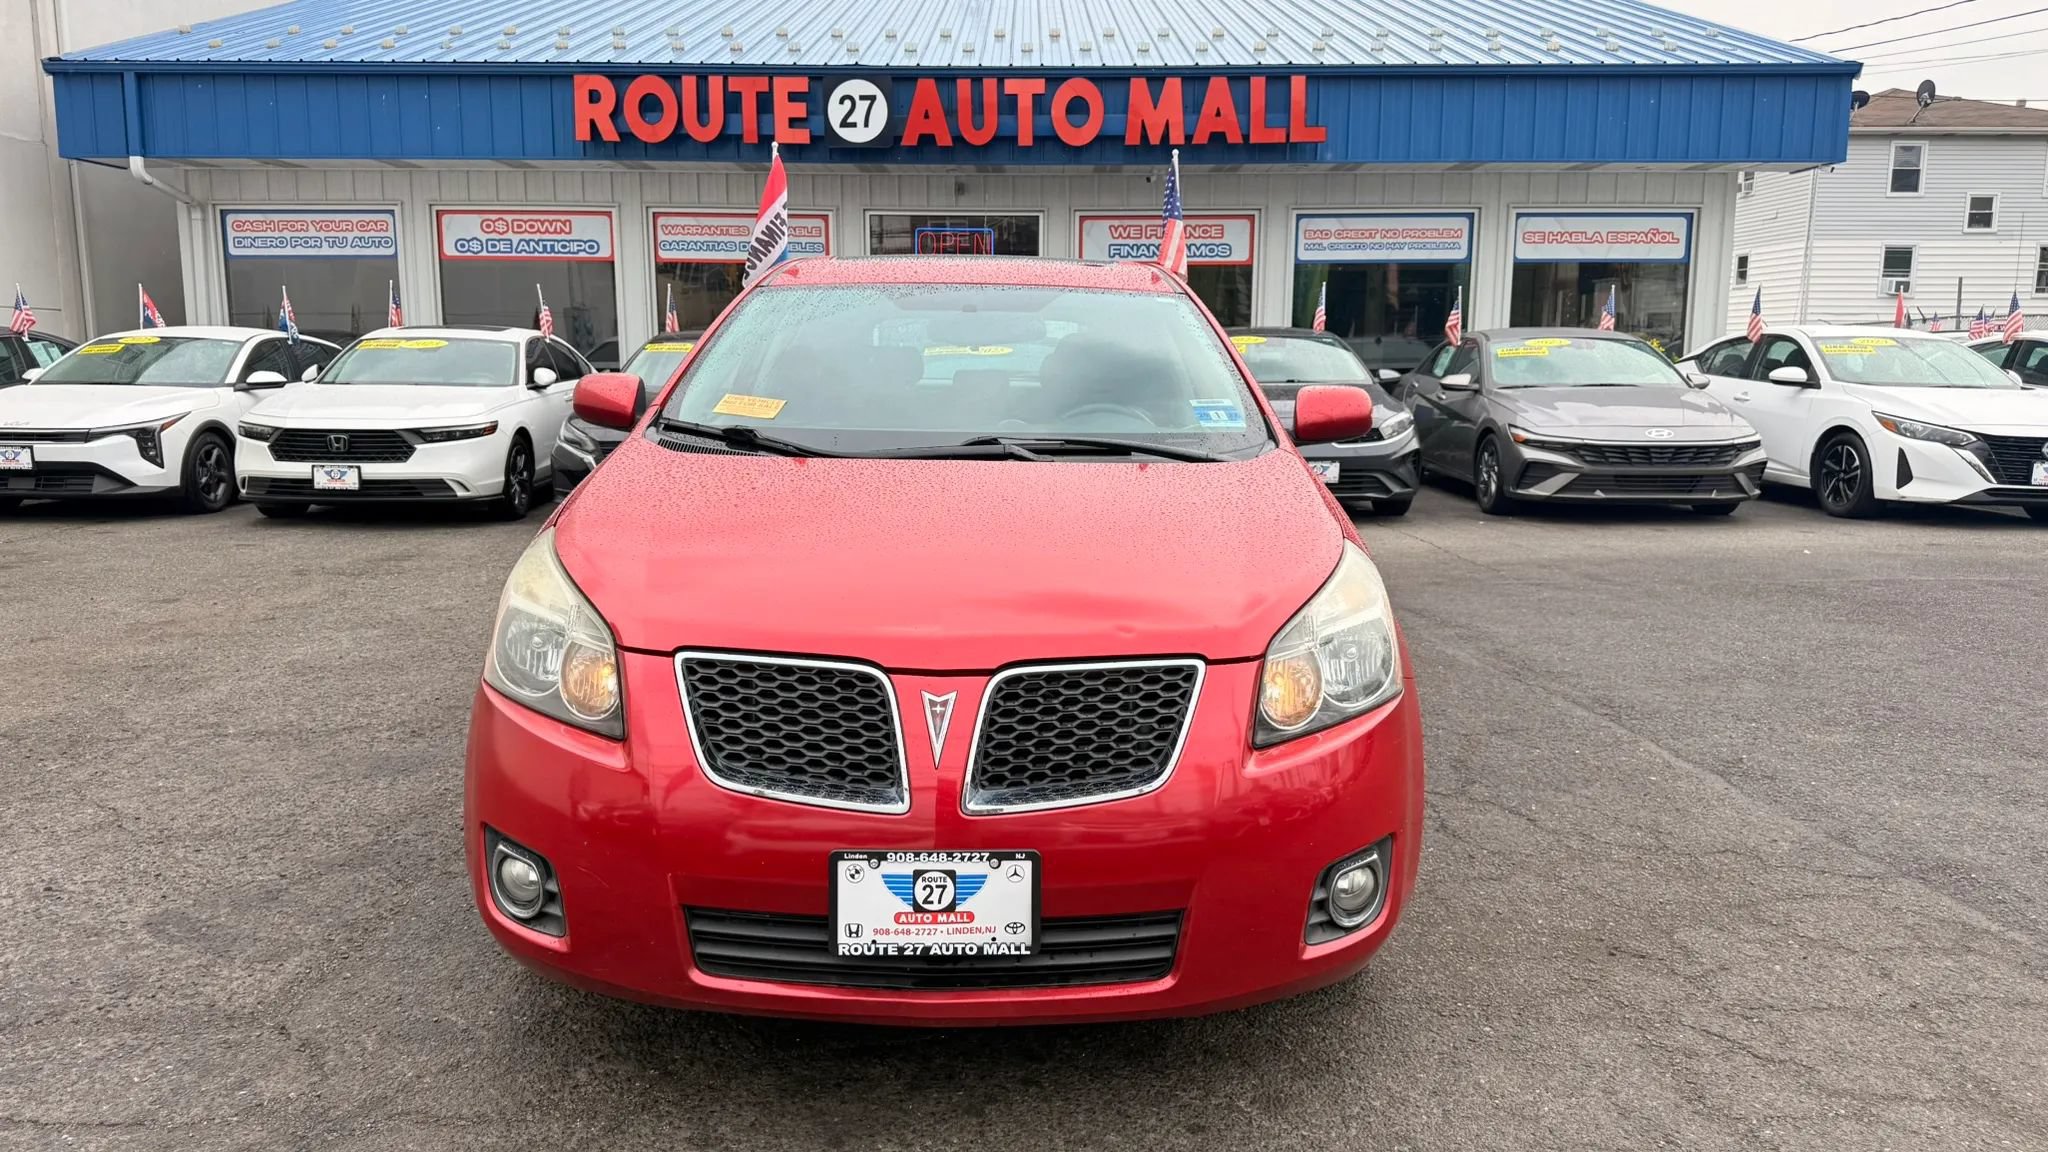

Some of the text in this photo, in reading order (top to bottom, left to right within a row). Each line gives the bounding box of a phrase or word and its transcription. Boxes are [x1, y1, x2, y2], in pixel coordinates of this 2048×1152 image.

[573, 74, 1327, 146] ROUTE 27 AUTO MALL
[232, 220, 388, 232] CASH FOR YOUR CAR
[512, 219, 571, 234] DOWN
[660, 224, 749, 237] WARRANTIES
[1109, 225, 1142, 239] WE
[1304, 228, 1463, 240] BAD CREDIT NO PROBLEM
[1523, 228, 1679, 243] SE HABLA ESPAÑOL
[233, 236, 392, 249] DINERO POR TU AUTO
[486, 239, 512, 253] DE
[515, 239, 599, 255] ANTICIPO
[659, 240, 736, 252] GARANTIAS
[917, 231, 992, 255] OPEN
[1304, 242, 1461, 251] MAL CREDITO NO HAY PROBLEMA
[886, 852, 991, 863] 908-648-2727
[921, 884, 948, 905] 27
[899, 913, 971, 923] AUTO MALL
[872, 926, 997, 936] 908-648-2727 LINDEN,NJ
[837, 943, 1031, 956] ROUTE 27 AUTO MALL
